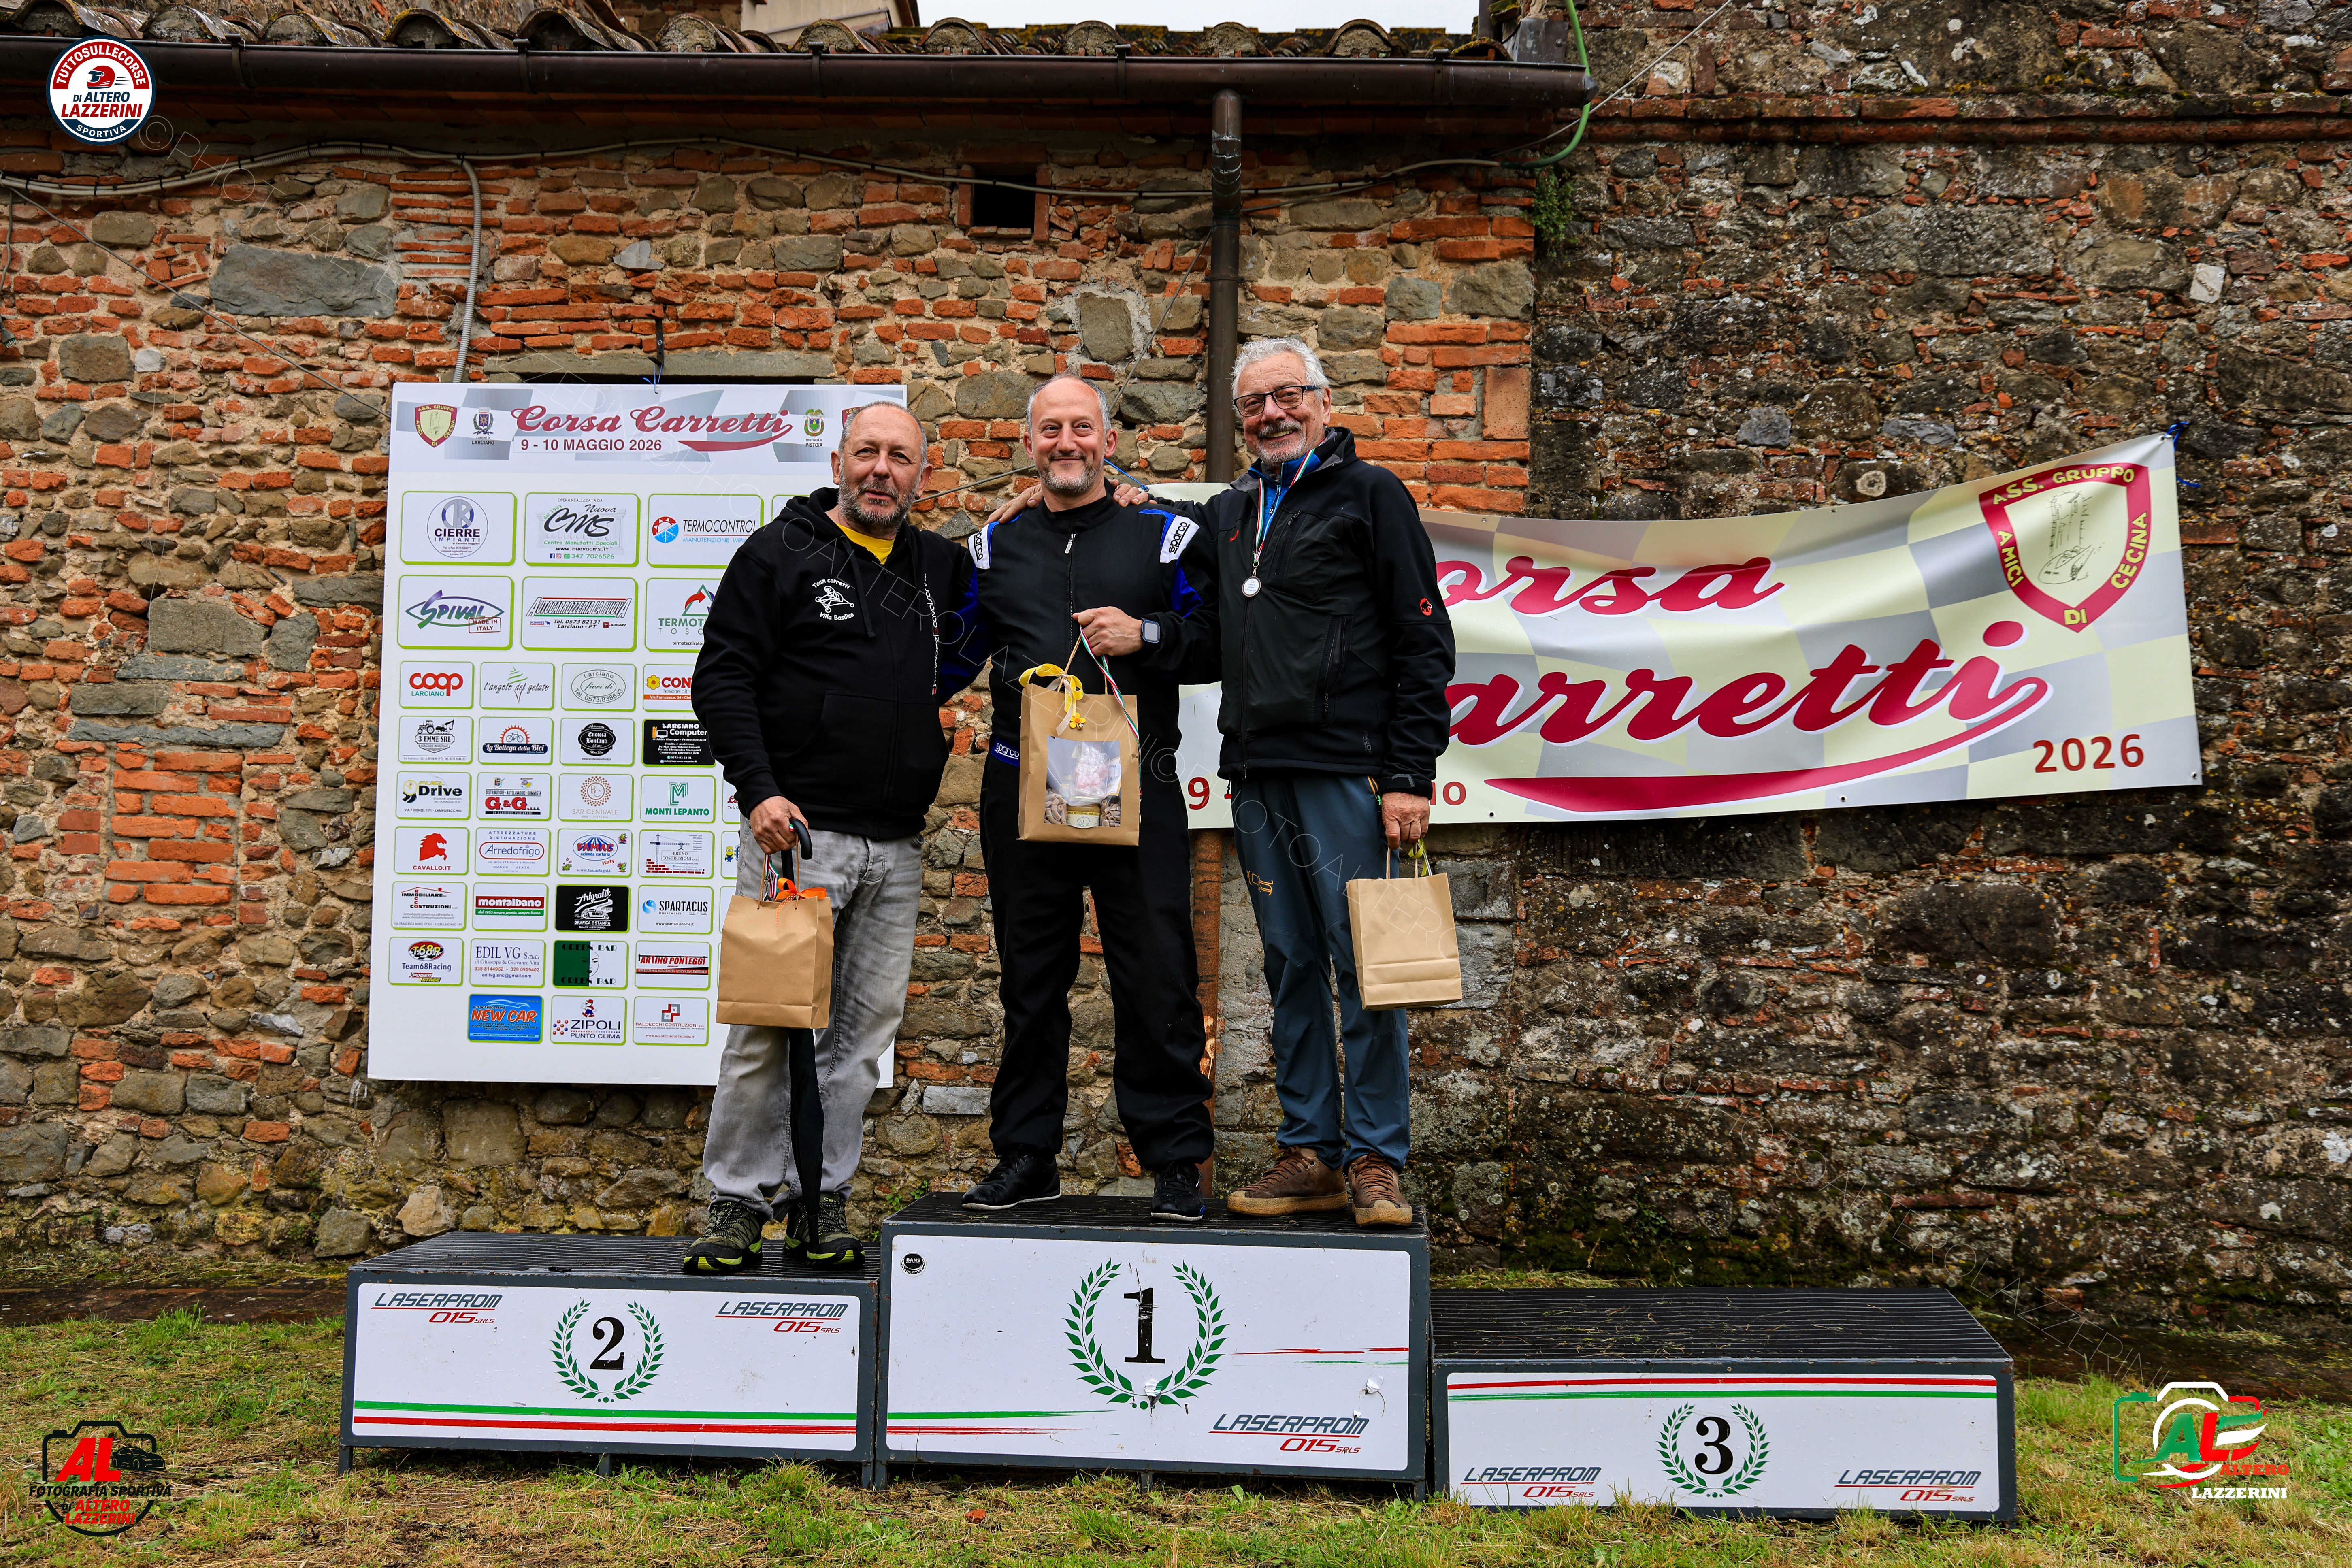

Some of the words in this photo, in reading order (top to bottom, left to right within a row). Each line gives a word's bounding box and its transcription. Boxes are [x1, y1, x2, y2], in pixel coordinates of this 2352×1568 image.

[511, 405, 622, 432] Corsa
[629, 406, 793, 434] Carretti
[521, 439, 527, 450] 9
[543, 439, 558, 450] 10
[564, 439, 624, 450] MAGGIO
[629, 440, 662, 451] 2026
[1992, 480, 2045, 506] ASS.
[2052, 466, 2135, 485] GRUPPO
[584, 504, 617, 513] Nuova
[435, 528, 480, 537] CIERRE
[683, 520, 756, 533] TERMOCONTROL
[1168, 521, 1188, 554] sparco
[1997, 529, 2024, 588] AMICI
[2110, 511, 2148, 590] CECINA
[812, 579, 826, 588] Team
[827, 578, 850, 589] carretti
[820, 611, 832, 620] Villa
[834, 612, 854, 621] Basilica
[2063, 609, 2088, 626] DI
[409, 673, 463, 696] coop
[484, 682, 511, 695] l'angolo
[527, 683, 549, 694] gelato
[1444, 620, 2049, 747] arretti
[584, 688, 623, 703] 0573/838633
[996, 742, 1019, 758] sparco
[2033, 734, 2144, 773] 2026
[419, 785, 462, 796] Drive
[1188, 777, 1209, 810] 9
[485, 844, 540, 857] Arredofrigo
[577, 843, 614, 852] FAMAC
[478, 898, 541, 907] montalbano
[659, 901, 708, 912] SPARTACUS
[476, 946, 501, 959] EDIL
[505, 947, 521, 959] VG
[669, 956, 706, 965] PONTEGGI
[402, 963, 451, 971] Team68Racing
[471, 1010, 506, 1022] NEW
[507, 1010, 537, 1023] CAR
[571, 1019, 621, 1031] ZIPOLI
[375, 1292, 503, 1308] LASERPROM
[718, 1300, 848, 1318] LASERPROM
[1123, 1287, 1165, 1364] 1
[589, 1316, 625, 1370] 2
[1214, 1413, 1370, 1434] LASERPROM
[1694, 1415, 1734, 1475] 3
[1464, 1466, 1602, 1483] LASERPROM
[1838, 1469, 1982, 1486] LASERPROM
